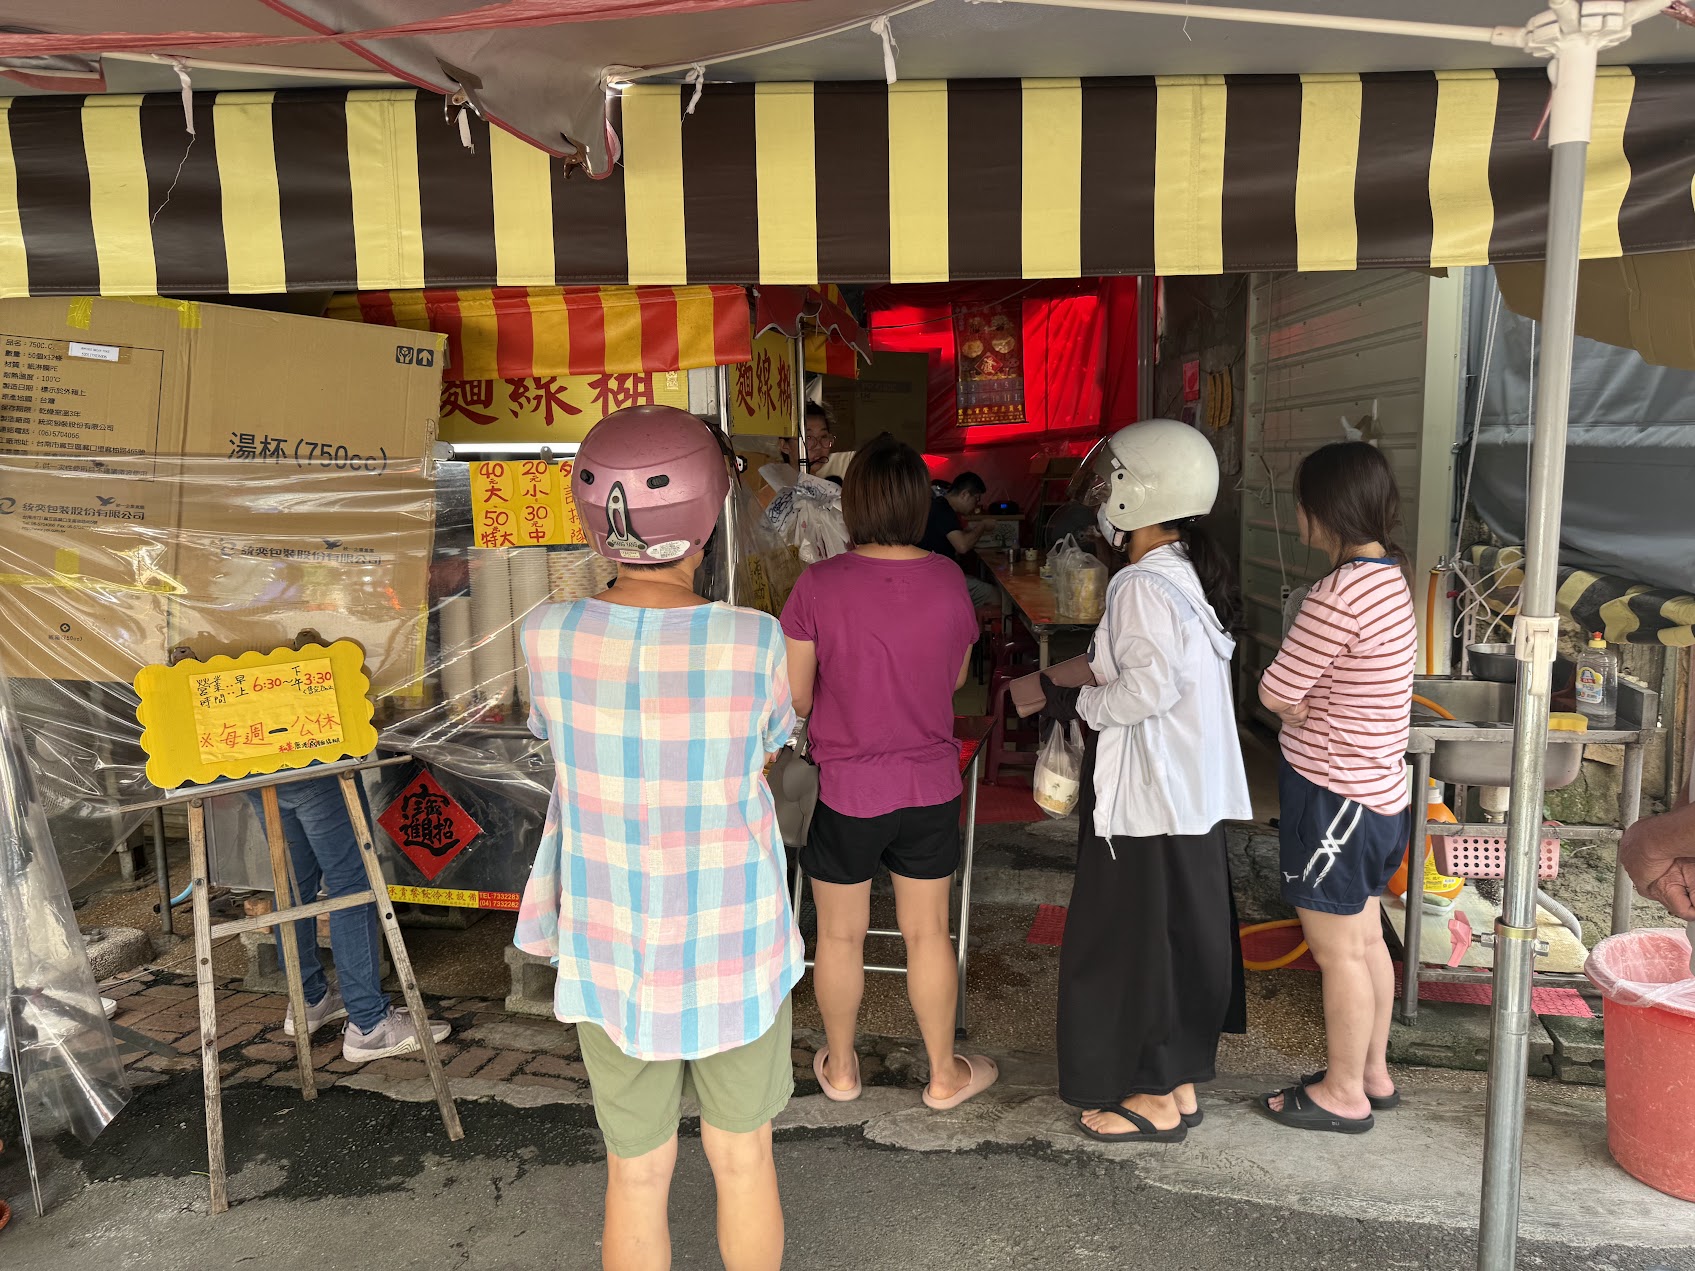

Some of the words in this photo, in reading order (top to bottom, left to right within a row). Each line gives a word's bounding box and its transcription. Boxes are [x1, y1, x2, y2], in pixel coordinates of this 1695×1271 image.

[736, 348, 792, 421] 麵線糊
[228, 431, 388, 476] 湯杯(750cc)
[479, 461, 504, 479] 40
[521, 460, 548, 476] 20
[484, 485, 509, 503] 大
[522, 483, 549, 497] 小
[483, 510, 509, 527] 50
[524, 505, 548, 521] 30
[481, 531, 516, 548] 特大
[528, 528, 546, 543] 中
